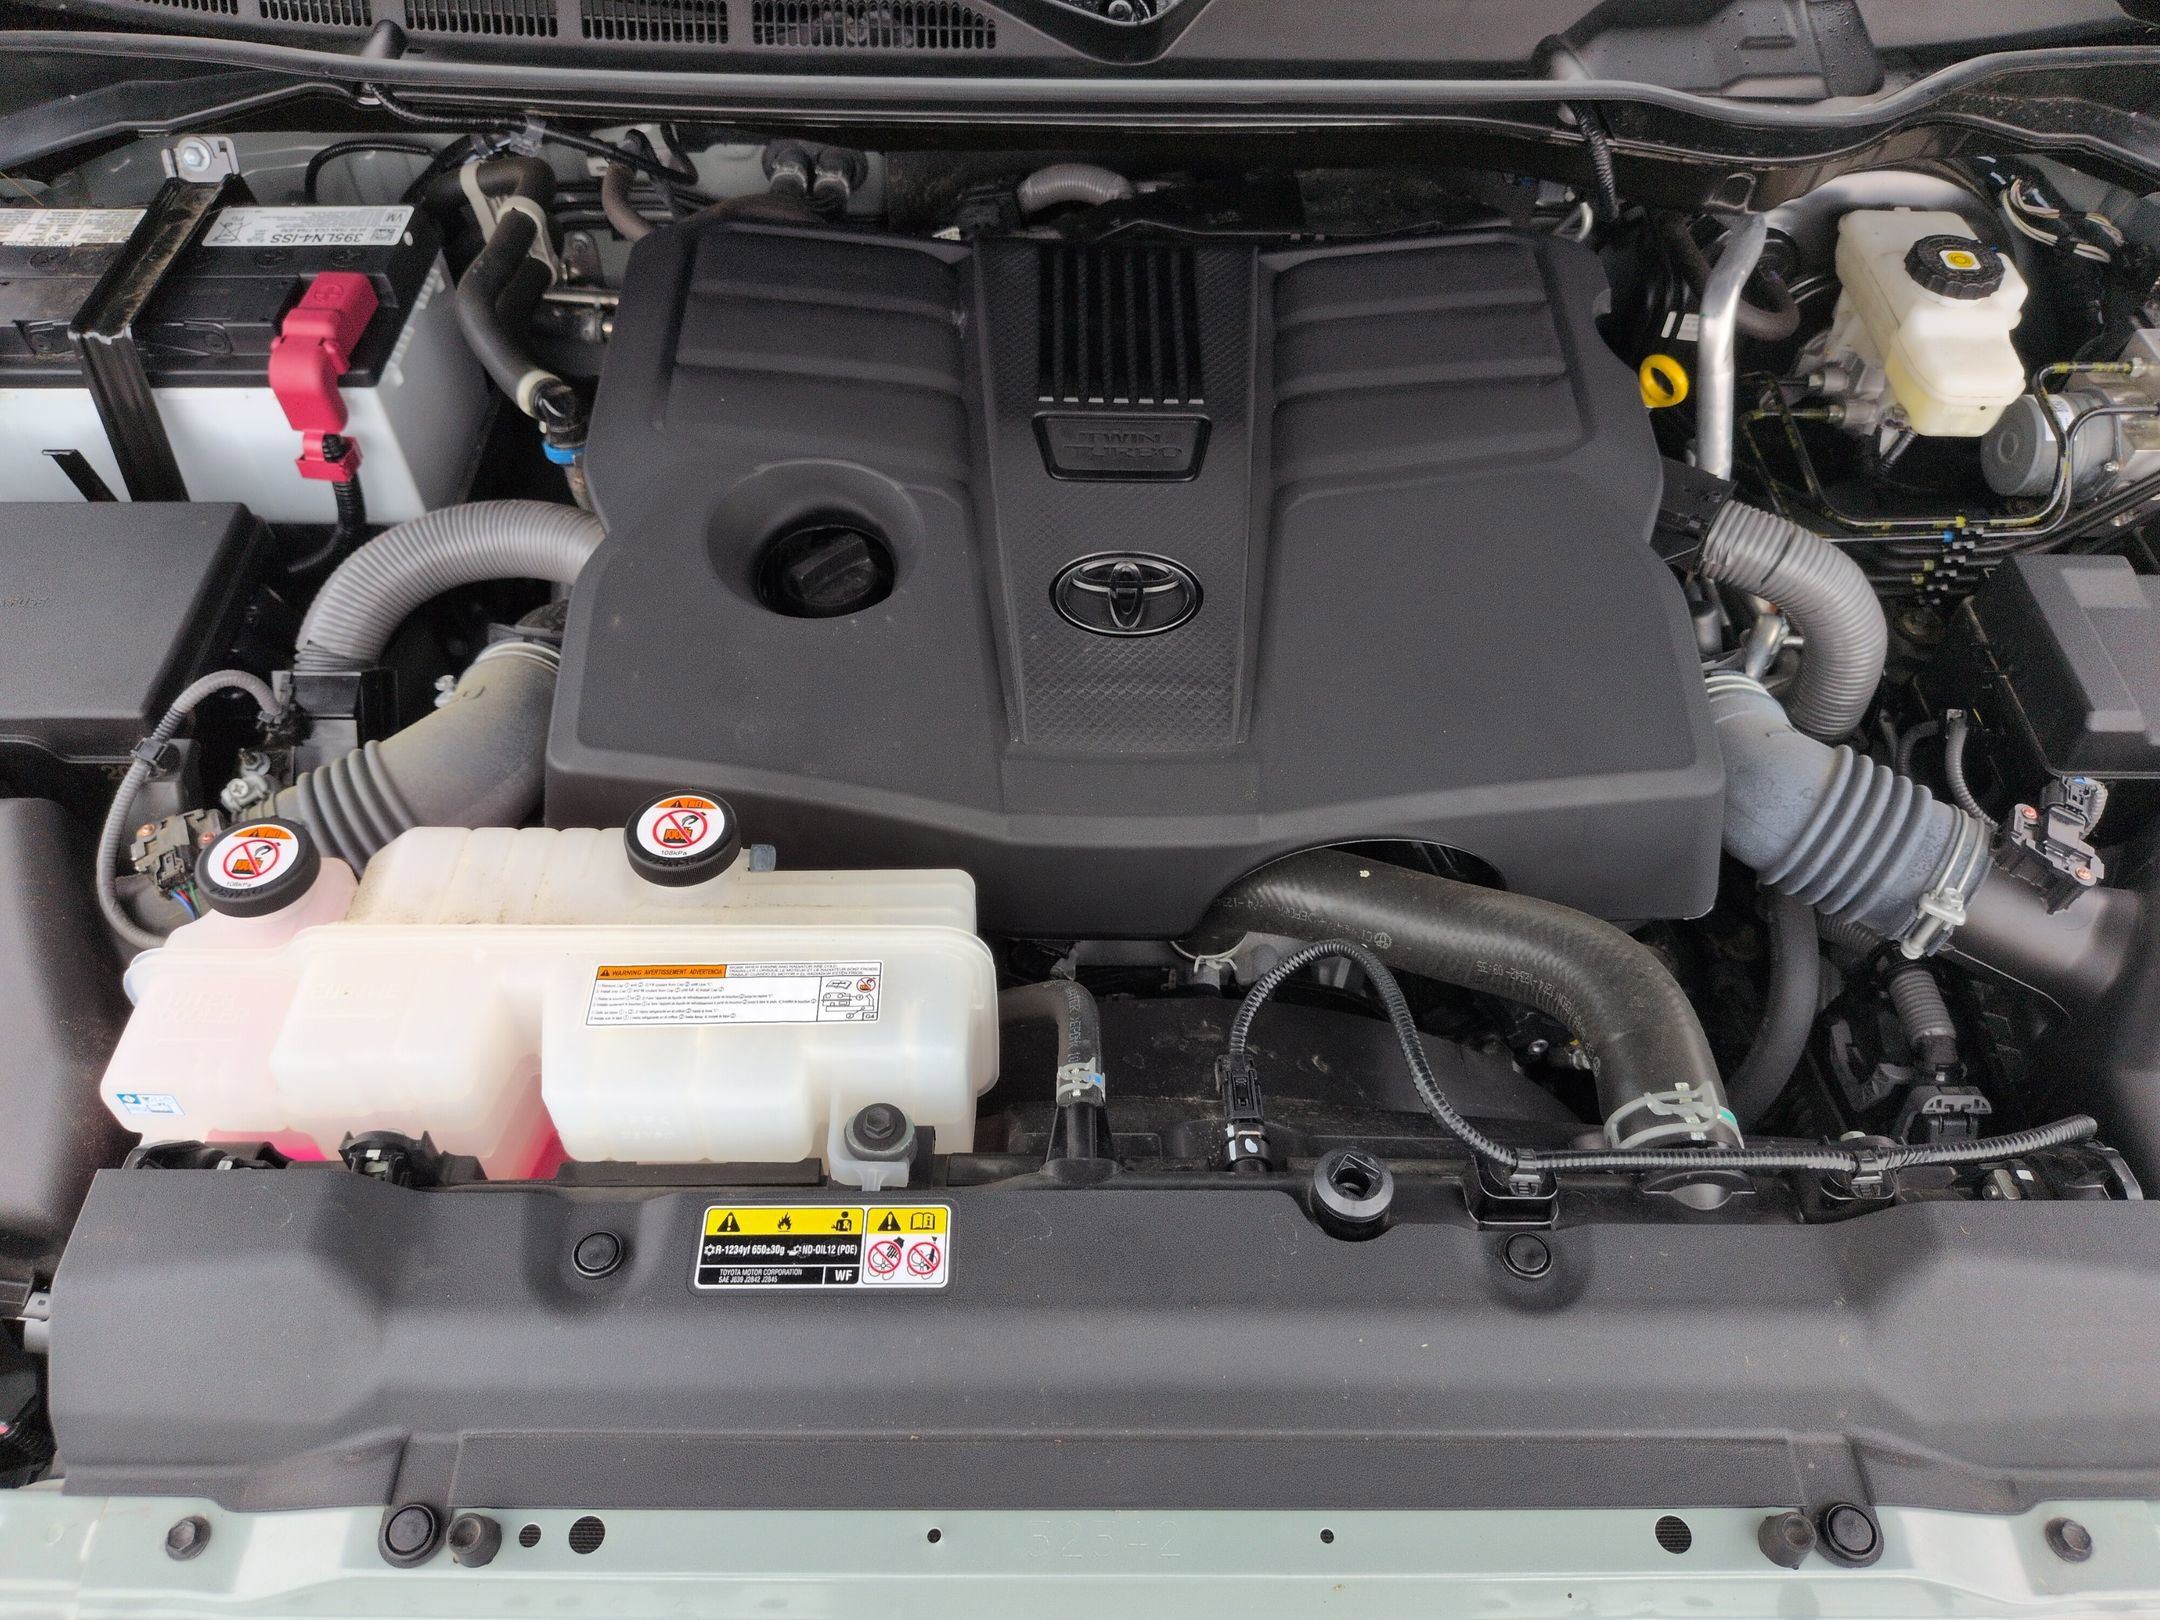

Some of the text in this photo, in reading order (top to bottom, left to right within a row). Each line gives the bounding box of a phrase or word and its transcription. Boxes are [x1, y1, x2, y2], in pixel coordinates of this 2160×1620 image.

[269, 233, 364, 244] 395LN4-ISS
[1079, 430, 1161, 443] TWIN
[1063, 444, 1183, 458] TURBO
[611, 968, 642, 976] WARNING
[715, 1244, 751, 1257] R-1234yf
[751, 1244, 785, 1257] 650±30g
[837, 1244, 858, 1256] (POE)
[720, 1268, 803, 1276] TOYOTA MOTOR CORPORATION
[834, 1269, 853, 1282] WF
[718, 1275, 730, 1283] SAE
